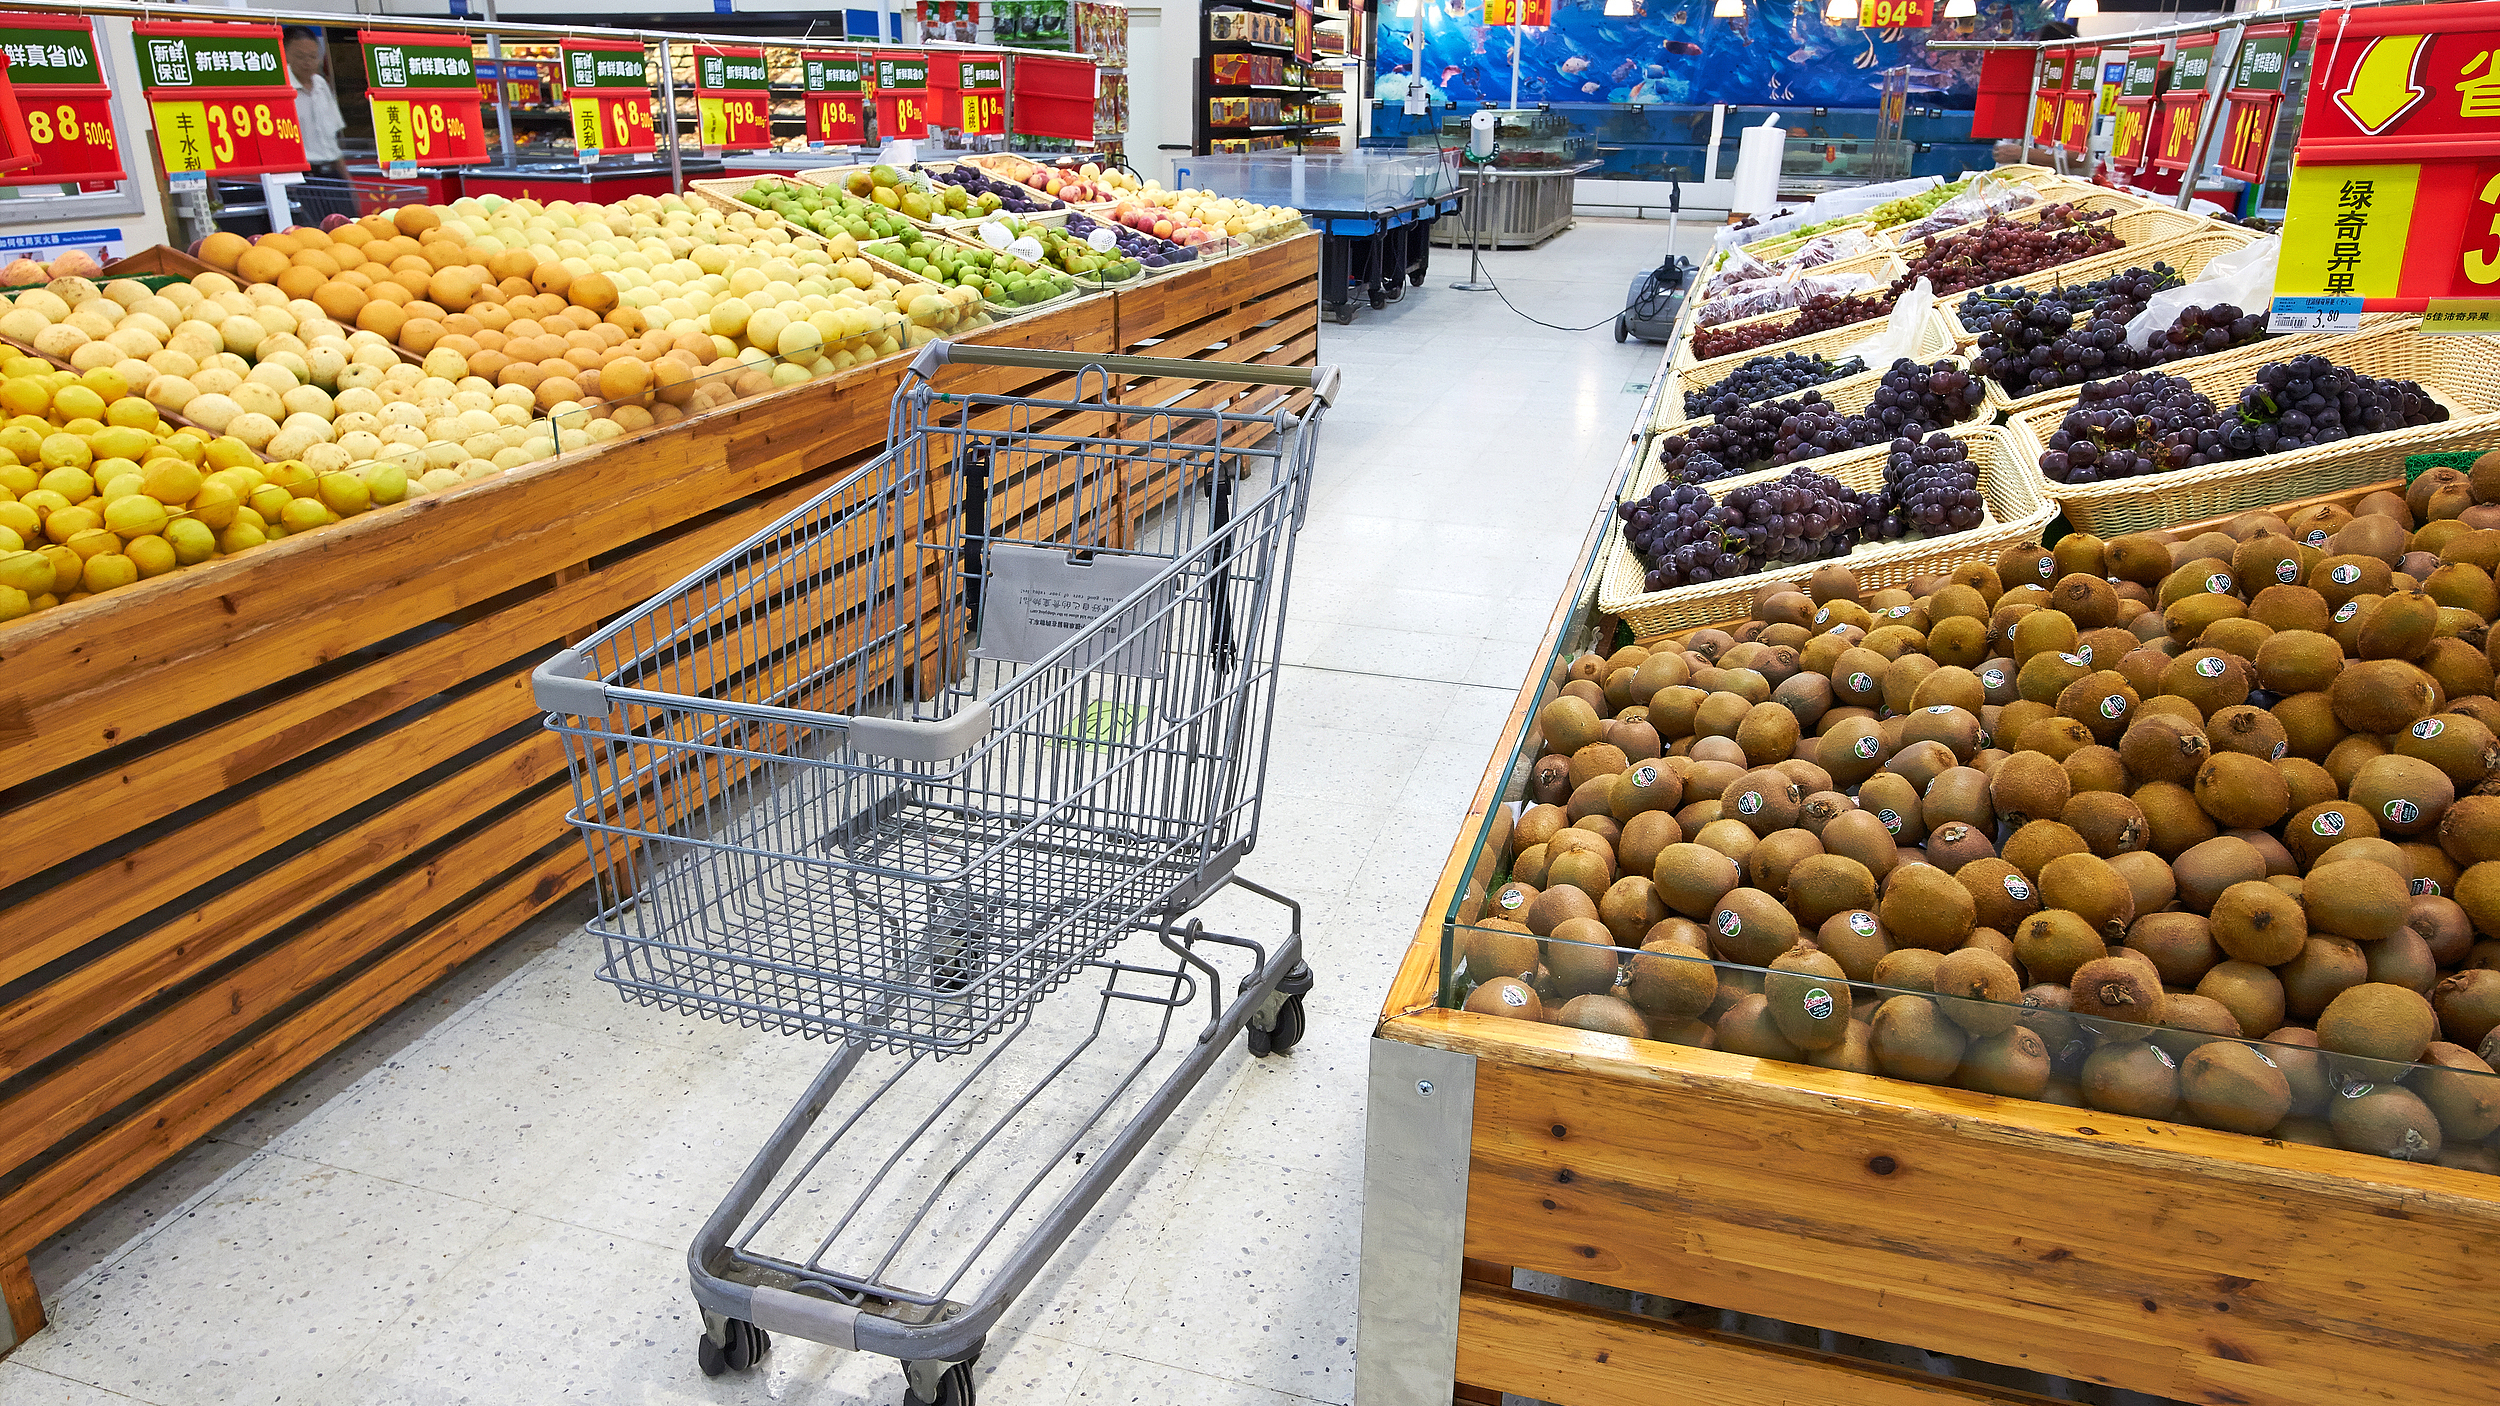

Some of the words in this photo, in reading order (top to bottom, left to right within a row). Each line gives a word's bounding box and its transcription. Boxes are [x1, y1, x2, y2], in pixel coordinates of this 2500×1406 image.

[1, 44, 88, 67] 鲜真省心
[154, 45, 184, 62] 新鲜
[195, 51, 277, 71] 新鲜真省心
[158, 63, 188, 80] 保证
[409, 57, 470, 75] 新鲜真省心
[84, 122, 113, 150] 500g
[276, 119, 300, 144] 500g
[2323, 180, 2374, 296] 绿奇异果
